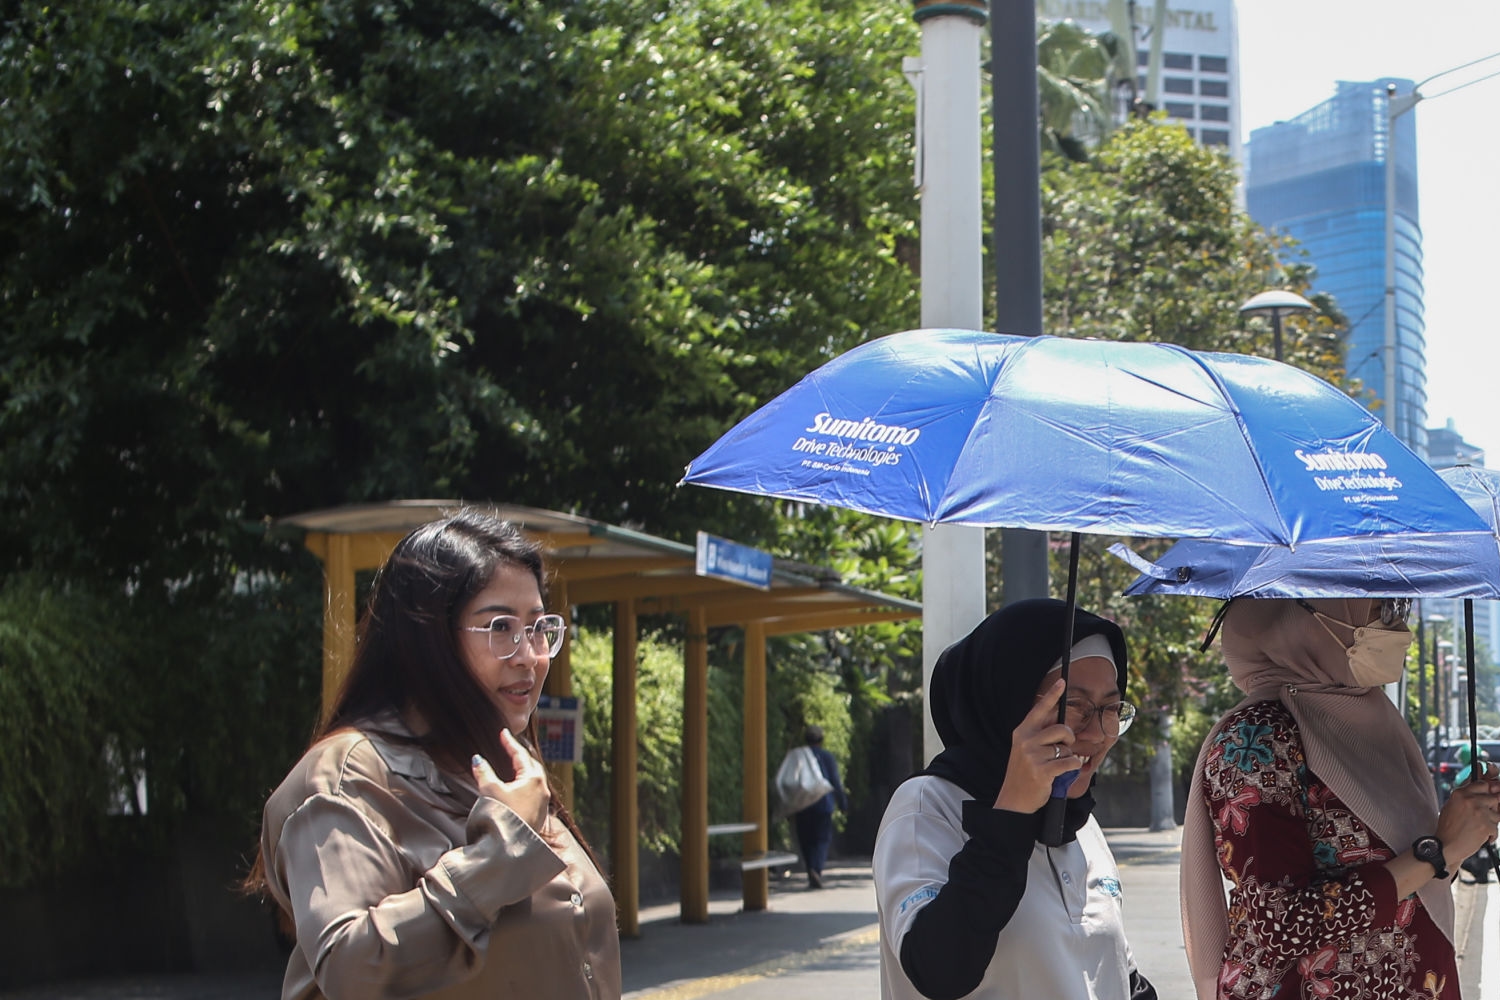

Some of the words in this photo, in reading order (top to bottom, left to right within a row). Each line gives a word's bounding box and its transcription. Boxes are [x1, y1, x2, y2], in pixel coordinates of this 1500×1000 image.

[806, 412, 920, 446] Sumitomo
[792, 437, 826, 456] Drive
[825, 442, 902, 467] Technologies
[1294, 448, 1387, 471] Sumitomo
